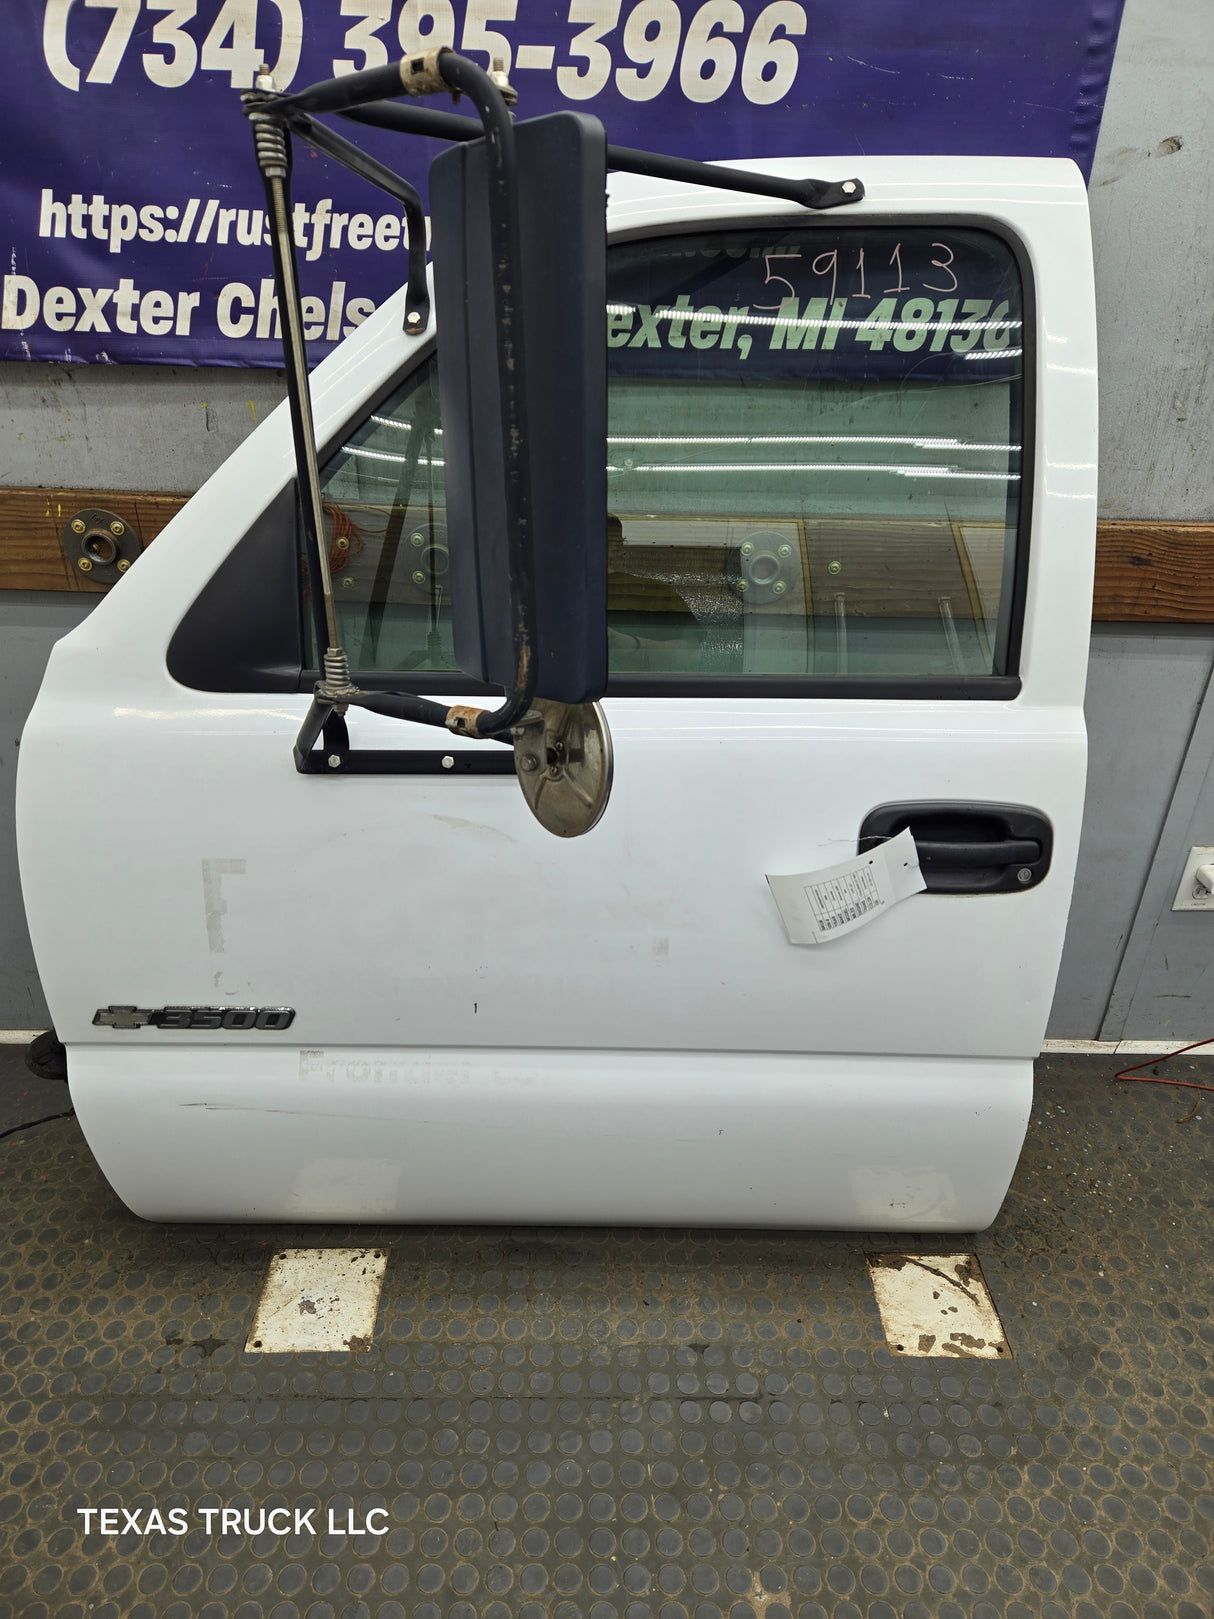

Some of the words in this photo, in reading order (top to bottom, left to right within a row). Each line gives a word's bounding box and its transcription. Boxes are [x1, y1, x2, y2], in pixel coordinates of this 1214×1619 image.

[43, 0, 303, 92] (734)
[332, 0, 808, 105] 395-3966
[1, 273, 201, 337] Dexter
[769, 296, 845, 351] MI
[752, 242, 958, 310] 59113
[157, 1006, 297, 1030] 3500
